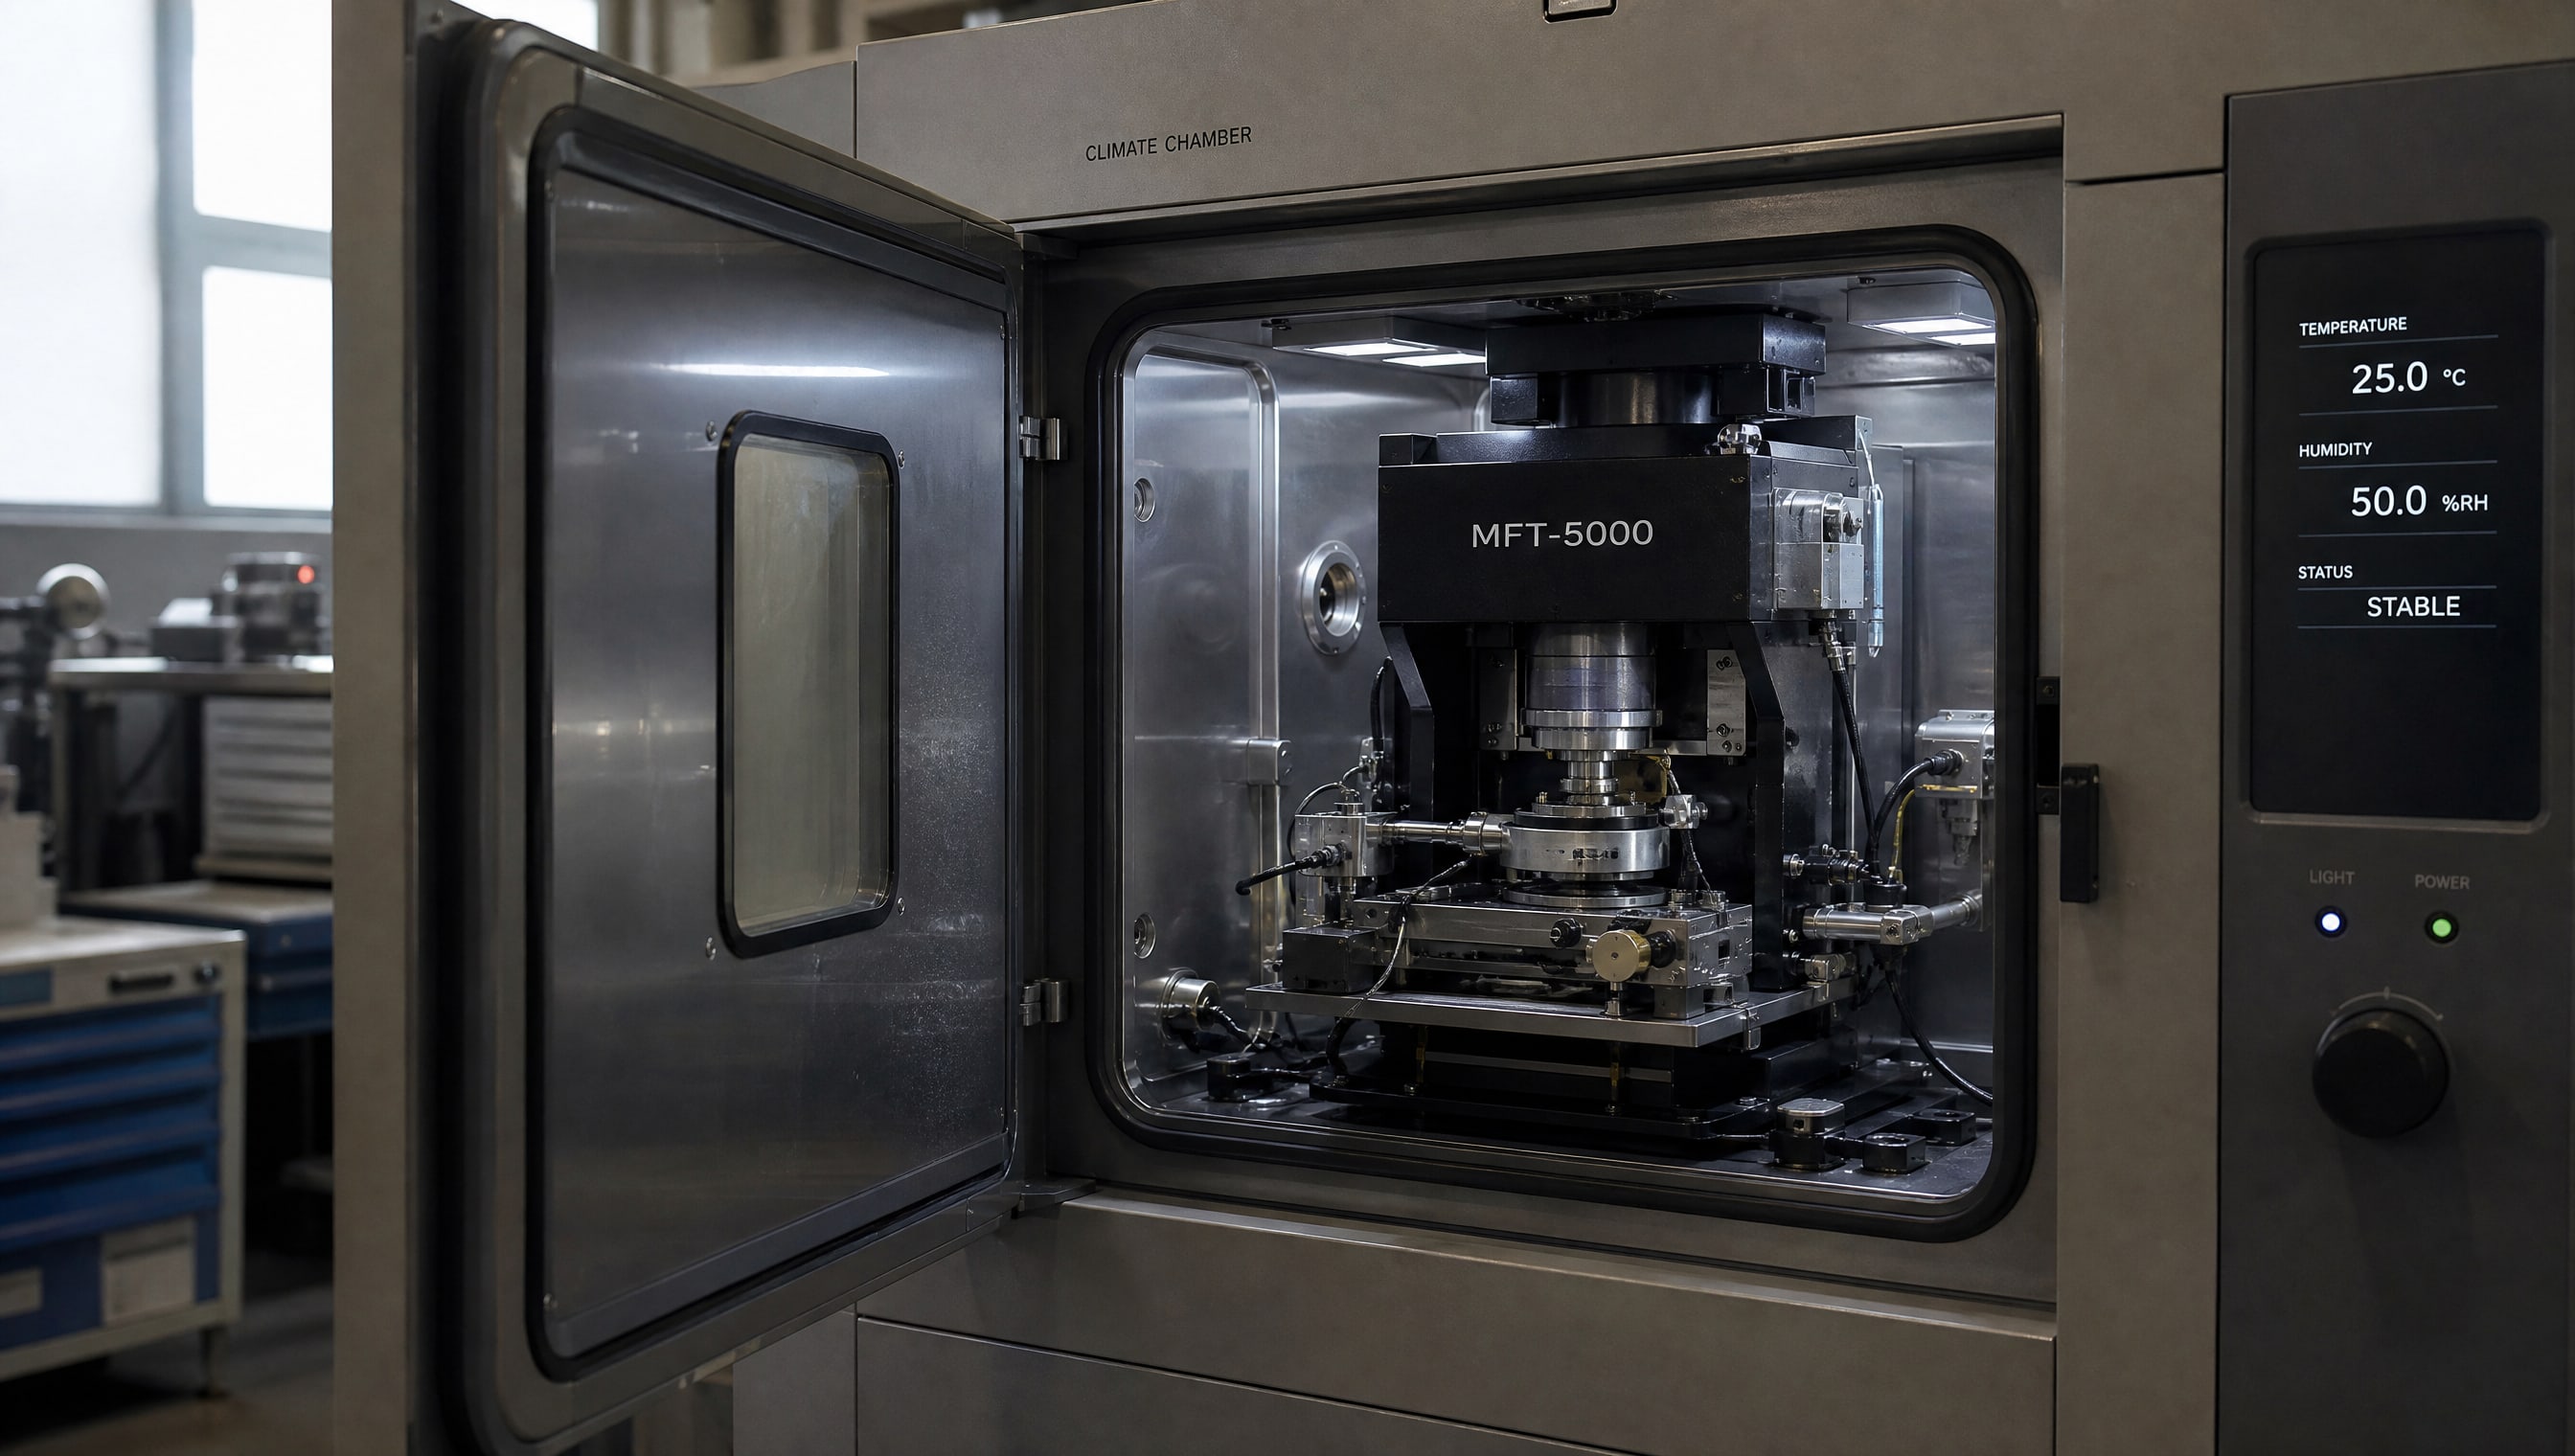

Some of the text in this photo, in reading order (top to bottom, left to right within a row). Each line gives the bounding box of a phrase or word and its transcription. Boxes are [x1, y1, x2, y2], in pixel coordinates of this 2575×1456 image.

[1085, 125, 1252, 162] CLIMATE CHAMBER
[2299, 316, 2407, 336] TEMPERATURE
[2352, 360, 2466, 395] 25.0 °C
[2299, 442, 2373, 458] HUMIDITY
[2351, 485, 2488, 517] 50.0 %RH
[1472, 519, 1653, 548] MFT-5000
[2298, 564, 2354, 580] STATUS
[2367, 595, 2461, 618] STABLE
[2309, 869, 2356, 885] LIGHT
[2414, 874, 2471, 890] POWER
